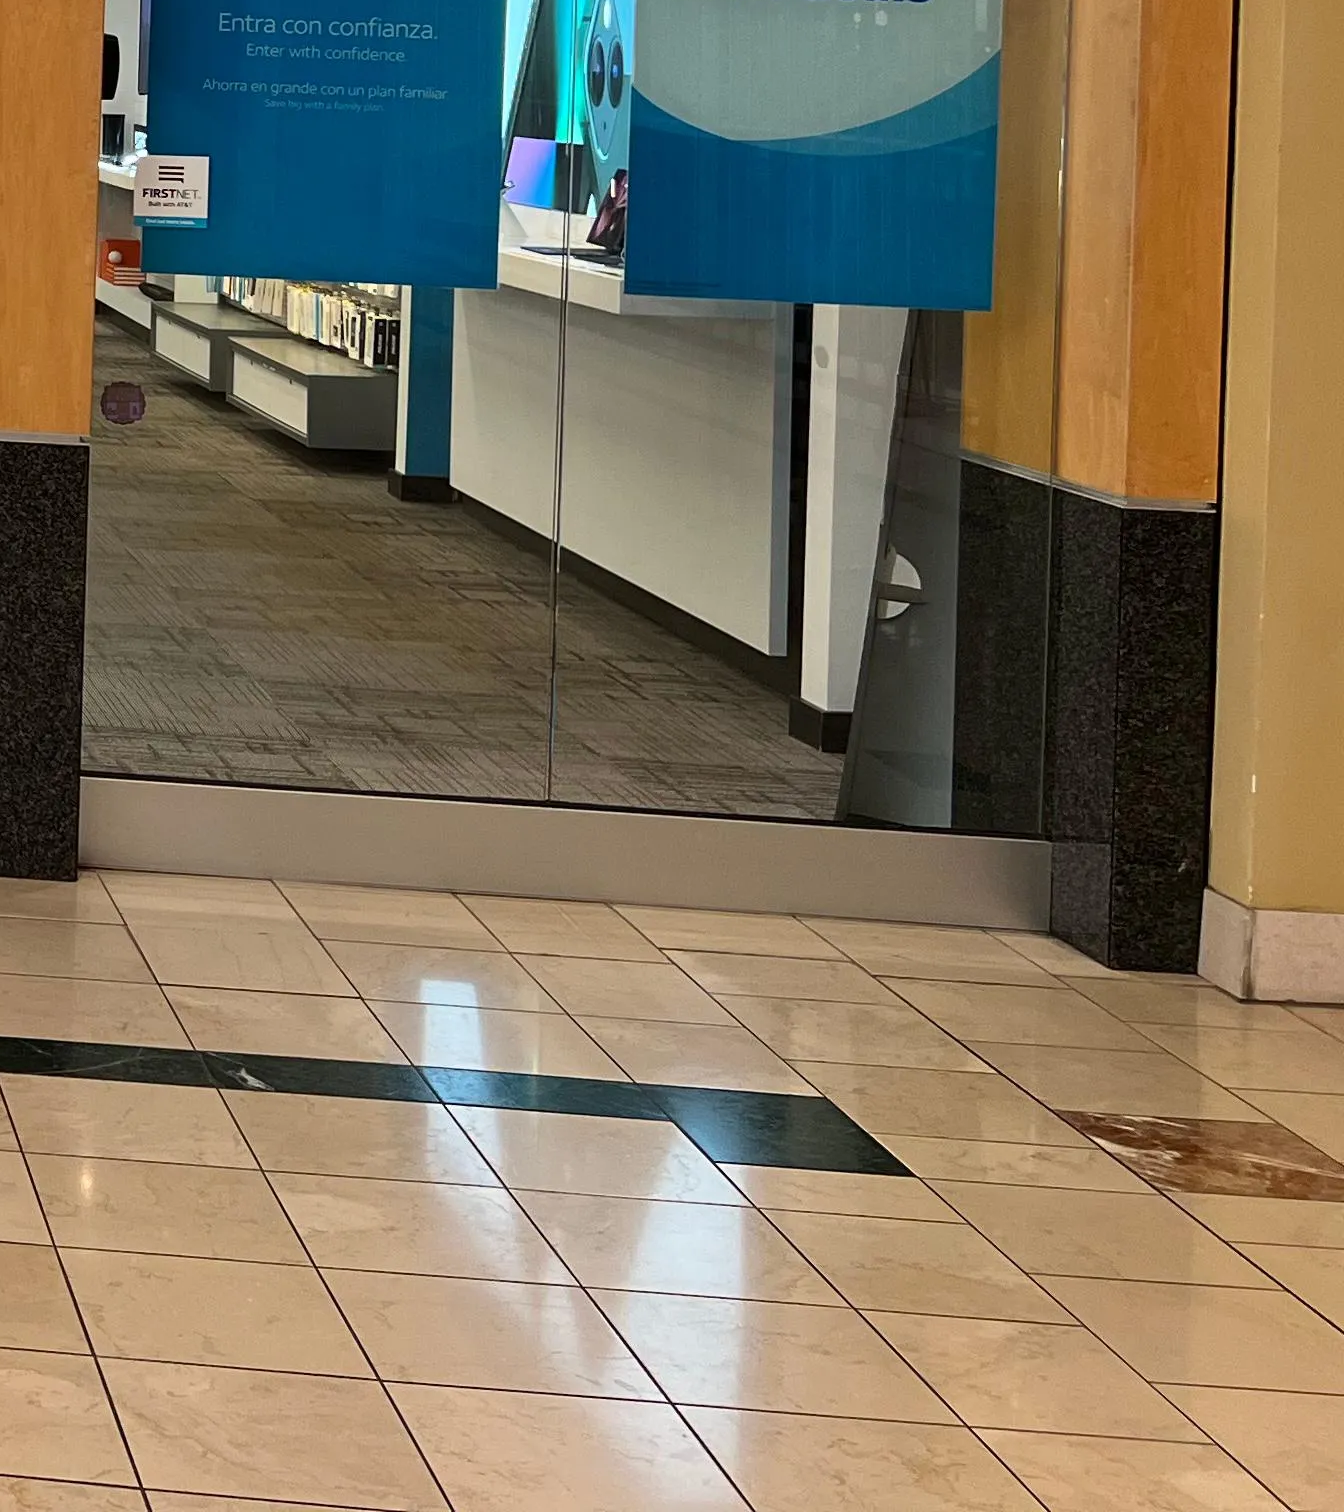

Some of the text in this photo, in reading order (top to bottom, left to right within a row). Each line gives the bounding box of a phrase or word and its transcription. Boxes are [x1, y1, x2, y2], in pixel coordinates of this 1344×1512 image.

[218, 12, 439, 39] Entra con confianza.
[246, 42, 285, 57] Enter
[288, 45, 321, 59] with
[202, 78, 248, 92] Ahorra
[250, 82, 268, 93] en
[270, 81, 318, 97] grande
[320, 85, 344, 96] con
[347, 86, 365, 97] un
[368, 83, 396, 99] plan
